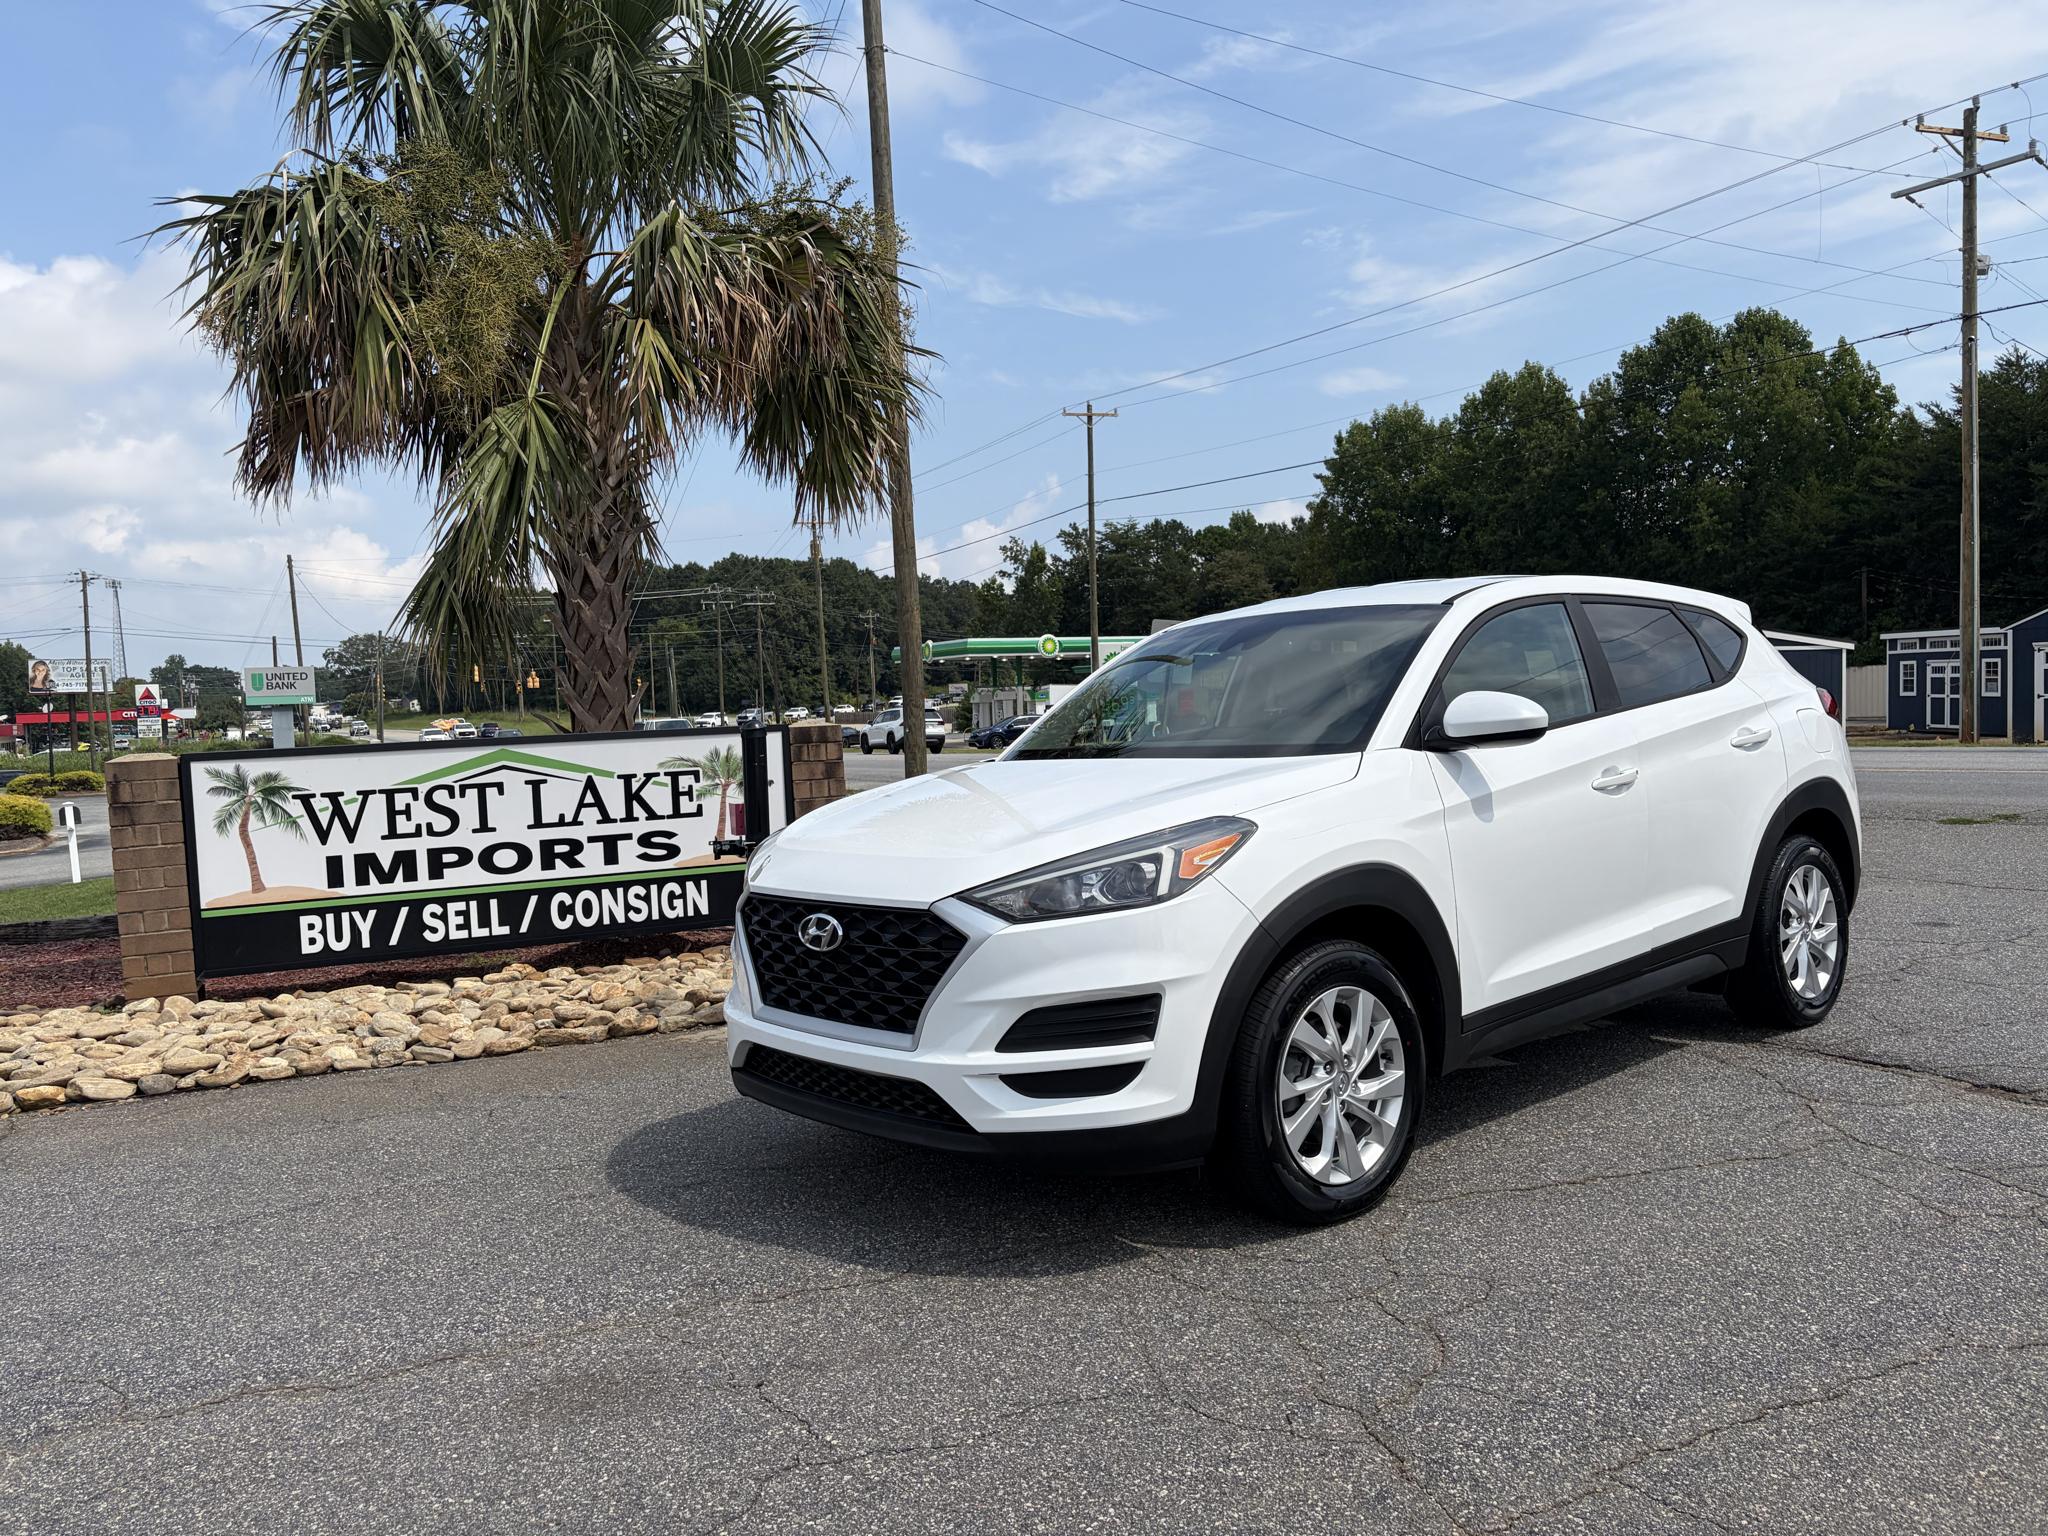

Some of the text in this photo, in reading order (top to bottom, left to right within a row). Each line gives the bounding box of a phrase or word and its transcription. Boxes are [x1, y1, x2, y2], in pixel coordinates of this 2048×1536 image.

[266, 672, 308, 681] UNITED
[266, 681, 297, 690] BANK
[292, 770, 703, 846] WEST LAKE
[326, 830, 681, 889] IMPORTS
[299, 879, 709, 955] BUY / SELL / CONSIGN
